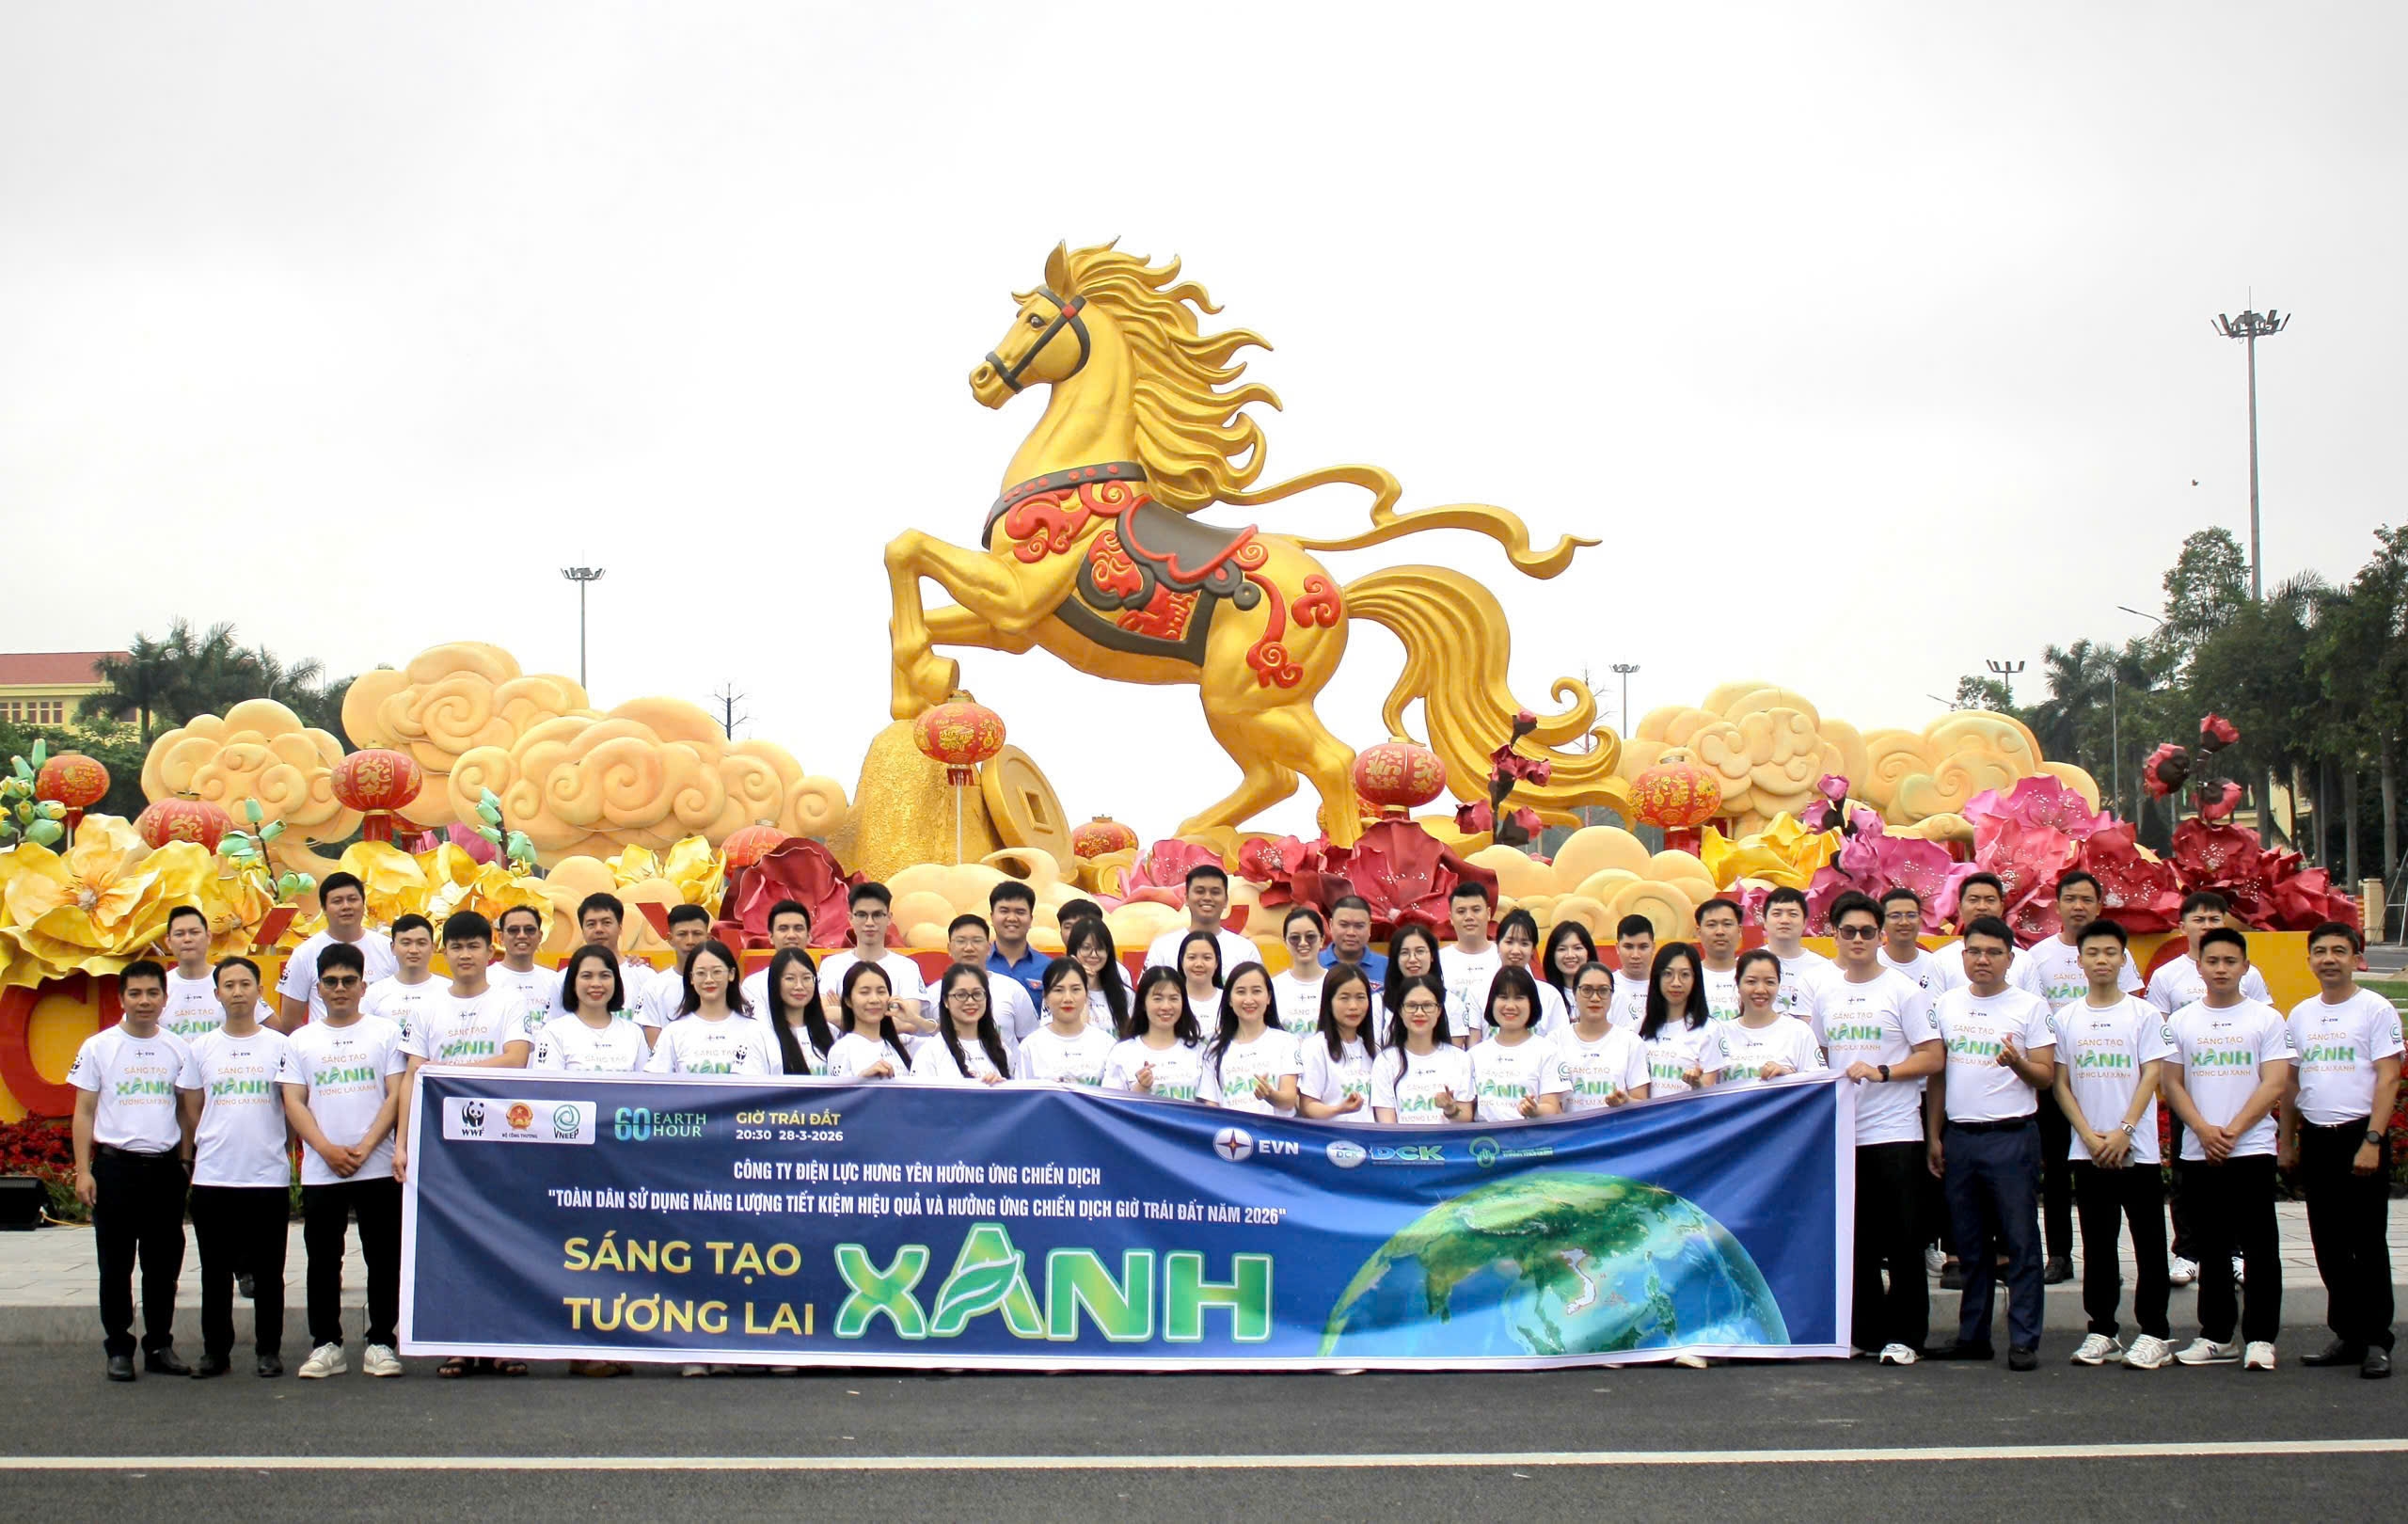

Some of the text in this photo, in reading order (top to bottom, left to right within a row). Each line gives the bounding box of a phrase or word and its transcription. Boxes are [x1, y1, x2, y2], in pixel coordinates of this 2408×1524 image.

[1573, 1077, 1617, 1095] ANH
[614, 1107, 651, 1141] 60
[654, 1113, 706, 1125] EARTH
[737, 1108, 841, 1126] GIỜ TRÁI ĐẤT
[462, 1128, 483, 1136] WWF
[553, 1127, 579, 1139] VNEEP
[654, 1125, 702, 1137] HOUR
[736, 1130, 844, 1141] 20:30 28-3-2026
[1259, 1140, 1299, 1155] EVN
[1370, 1145, 1446, 1161] DCK
[734, 1159, 1101, 1188] CÔNG TY ĐIỆN LỰC HƯNG YÊN HƯỞNG ỨNG CHIẾN DỊCH
[548, 1186, 1287, 1225] "TOÀN DÂN SỬ DỤNG NĂNG LƯỢNG TIẾT KIỆM HIỆU QUẢ VÀ HƯỞNG ỨNG CHIẾN DỊCH GIỜ TRÁI ĐẤT NĂM 2026"
[563, 1230, 801, 1285] SÁNG TẠO
[834, 1223, 1274, 1343] XANH
[563, 1293, 814, 1336] TƯƠNG LAI
